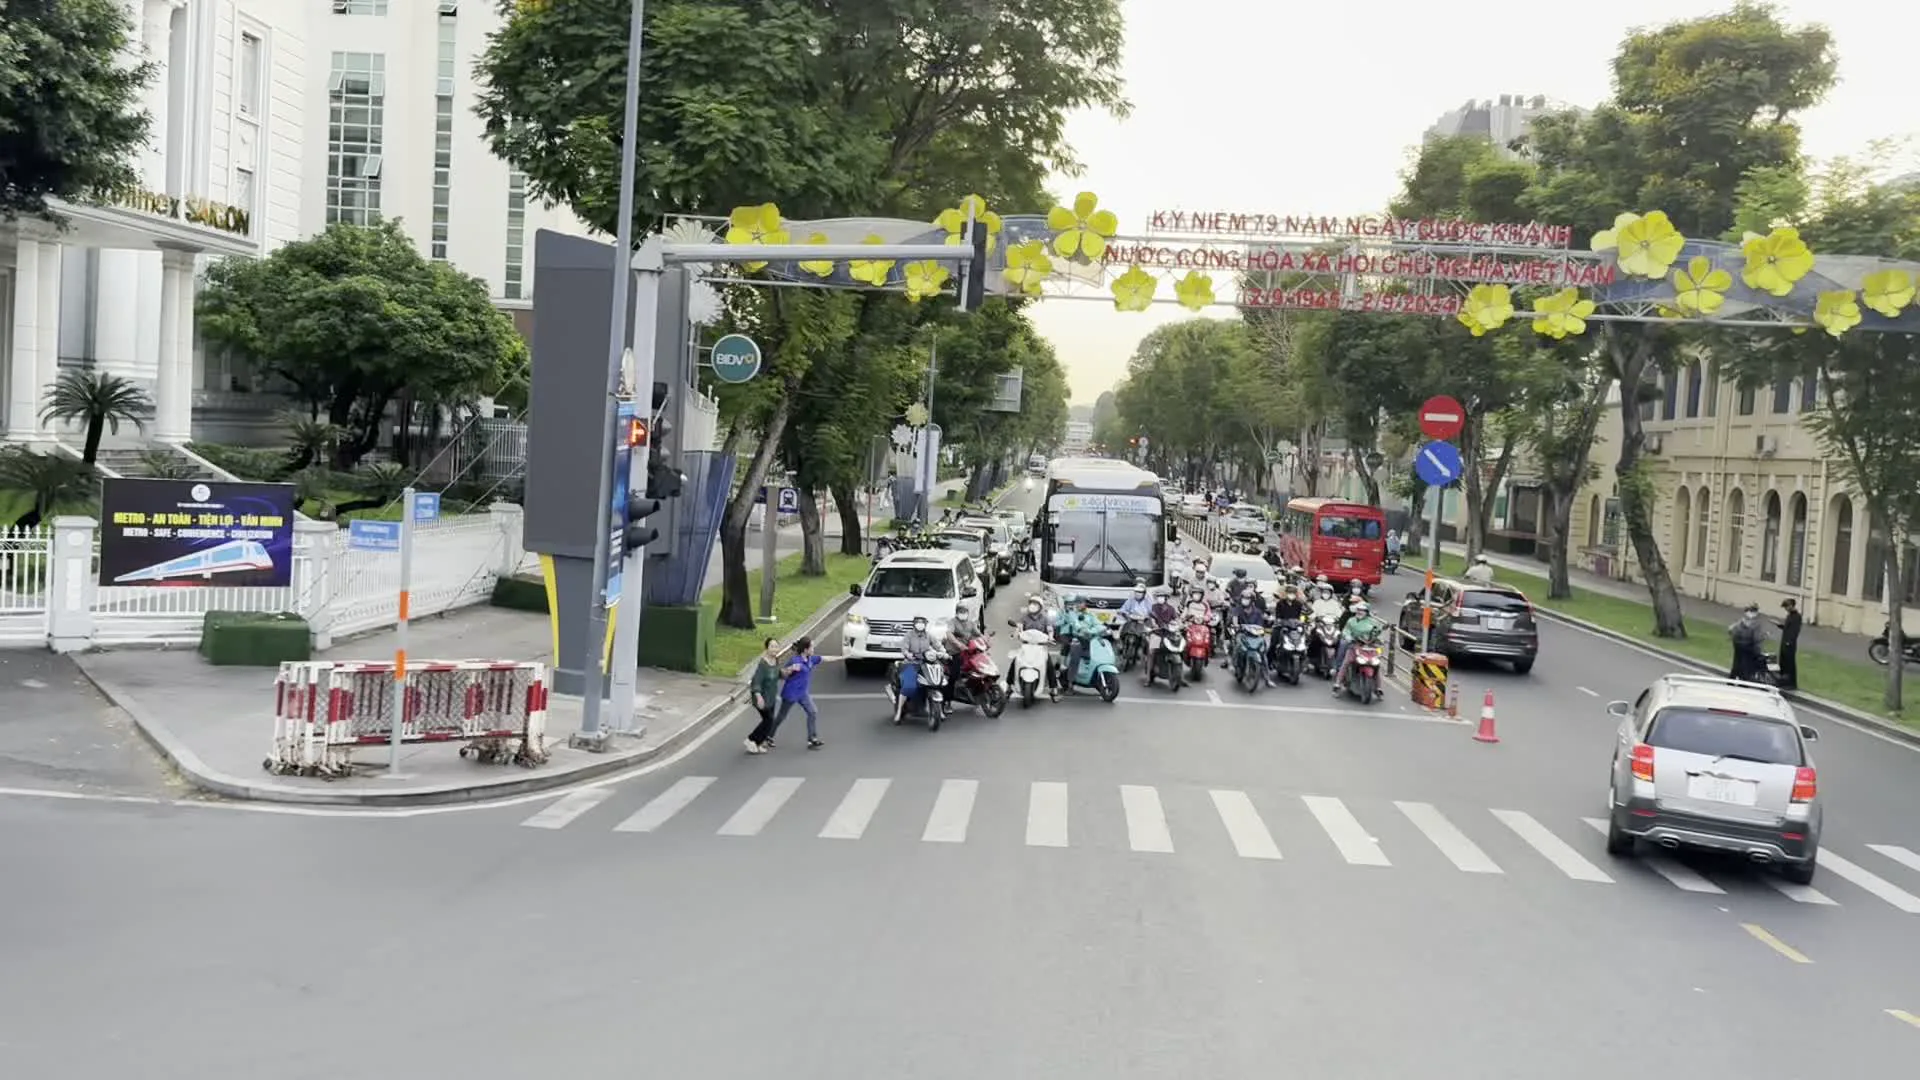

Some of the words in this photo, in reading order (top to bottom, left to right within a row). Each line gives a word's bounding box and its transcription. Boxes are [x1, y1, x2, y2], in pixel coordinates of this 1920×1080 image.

[1254, 214, 1278, 232] 79
[1564, 262, 1617, 285] NAM
[716, 353, 744, 366] BIDV
[113, 512, 146, 524] METRO
[152, 513, 166, 525] AN
[168, 511, 192, 526] TOÀN
[154, 528, 172, 538] SAFE
